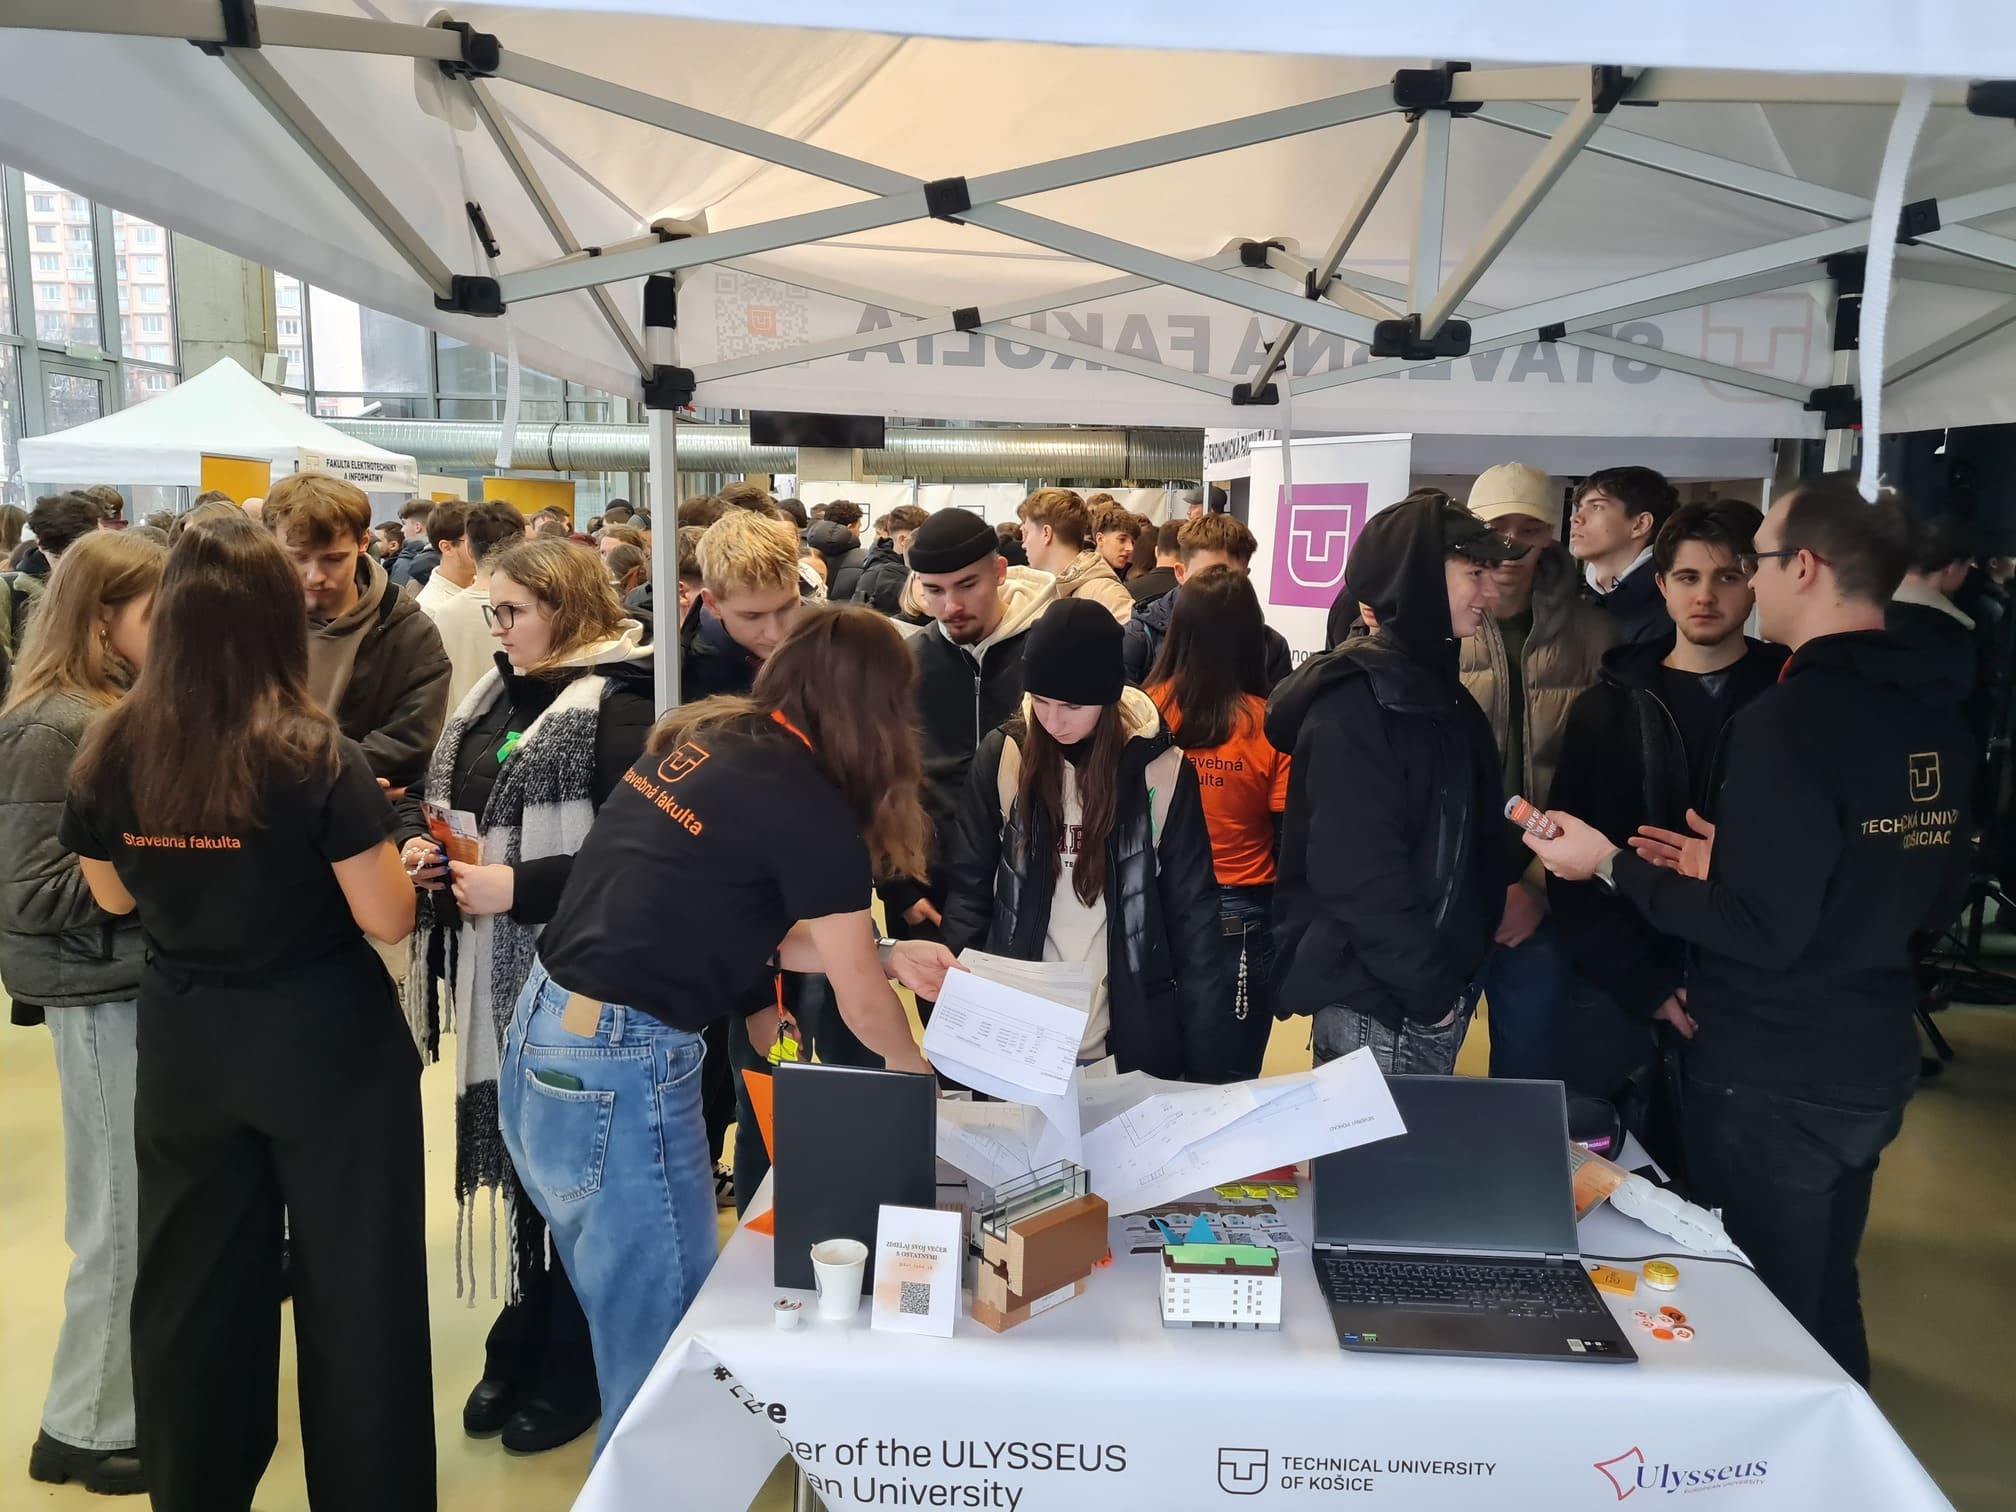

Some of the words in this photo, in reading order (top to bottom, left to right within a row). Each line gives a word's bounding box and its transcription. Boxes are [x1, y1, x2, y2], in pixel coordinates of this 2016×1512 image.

[326, 458, 350, 469] FAKULTA
[351, 460, 397, 472] ELEKTROTECHNIKY
[344, 472, 348, 480] A
[348, 472, 384, 483] INFORMATIKY
[654, 790, 703, 836] fakulta
[189, 835, 241, 849] fakulta
[835, 1438, 868, 1466] of
[878, 1438, 931, 1467] the
[942, 1440, 1127, 1472] ULYSSEUS
[1281, 1456, 1382, 1473] TECHNICAL
[1388, 1460, 1496, 1476] UNIVERSITY
[1281, 1475, 1304, 1489] OF
[1309, 1474, 1374, 1491] KOŠICE
[1636, 1460, 1768, 1493] Ulysseus
[853, 1477, 1023, 1512] University
